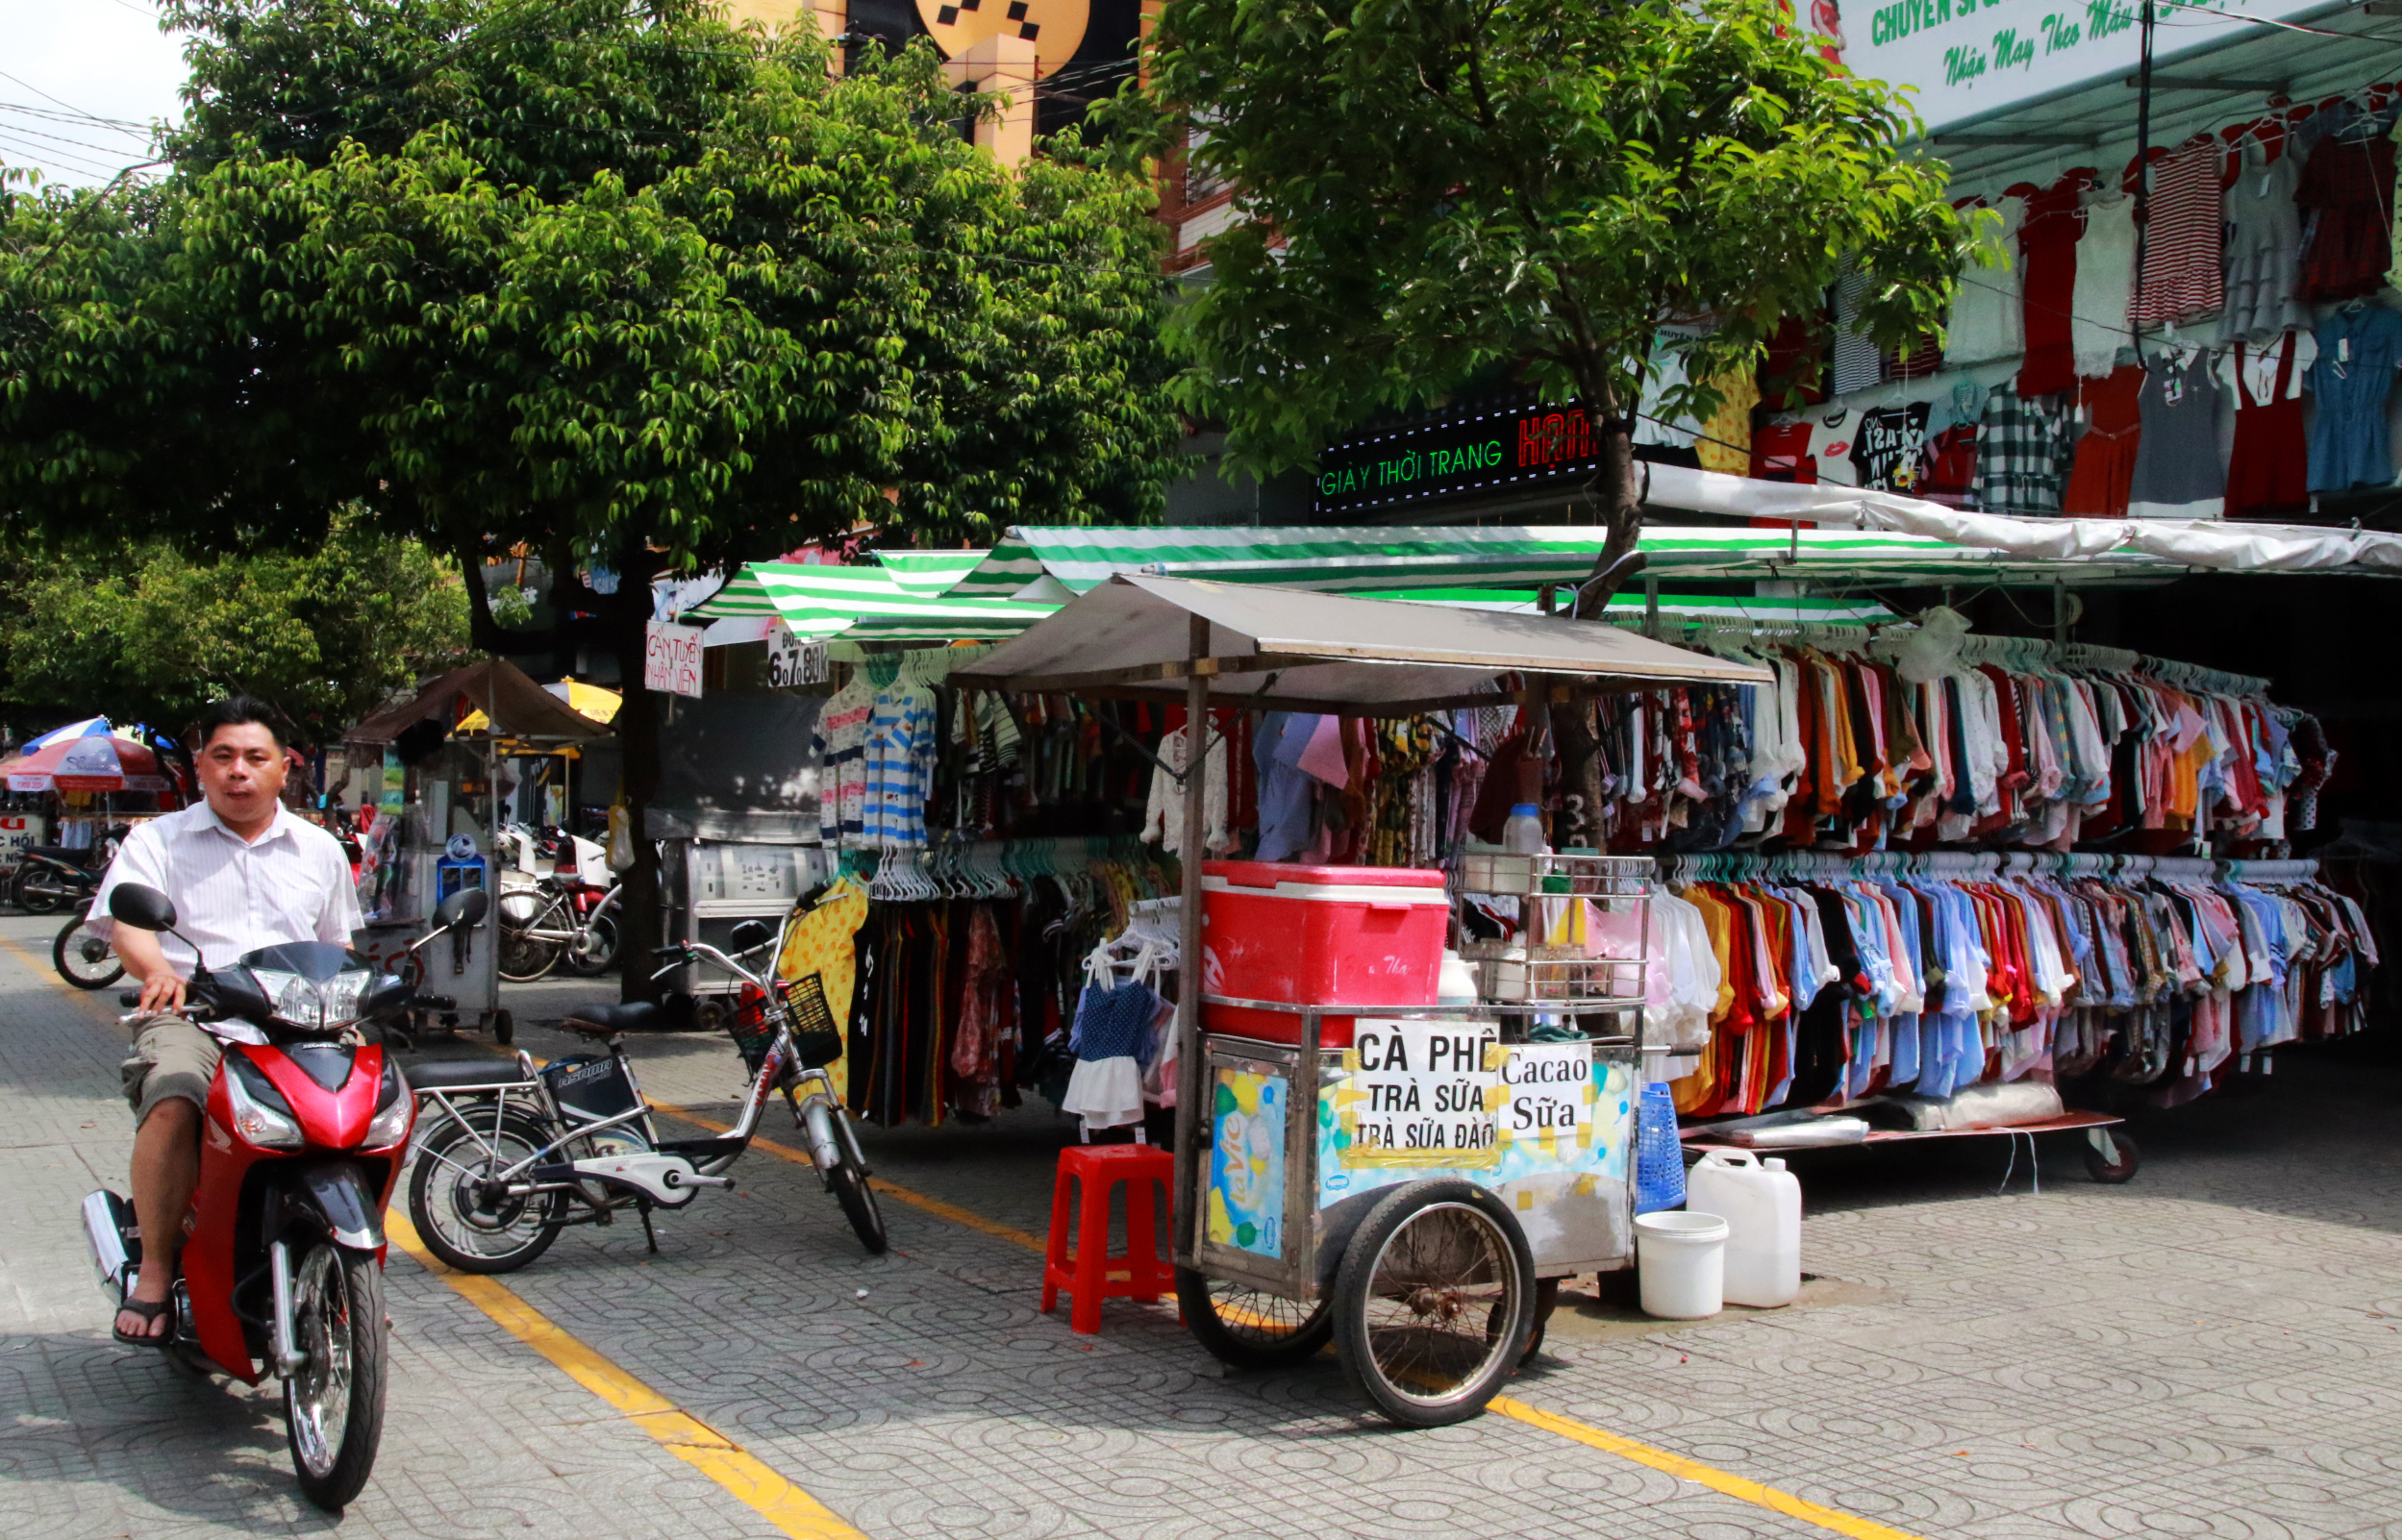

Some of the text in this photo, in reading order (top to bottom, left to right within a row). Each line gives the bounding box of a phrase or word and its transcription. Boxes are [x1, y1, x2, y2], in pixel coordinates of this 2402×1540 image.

[1943, 44, 1987, 88] Nhận
[1992, 30, 2035, 72] May
[2040, 12, 2080, 57] Theo
[1321, 460, 1370, 495] GIÀY
[1378, 450, 1422, 486] THỜI
[1430, 440, 1502, 477] TRANG
[1358, 1025, 1497, 1073] CÀ PHÊ
[1502, 1052, 1588, 1084] Cacao
[1367, 1078, 1485, 1112] TRÀ SỮA
[1513, 1096, 1577, 1130] Sữa
[1356, 1116, 1495, 1150] TRÀ SỮA ĐÀO
